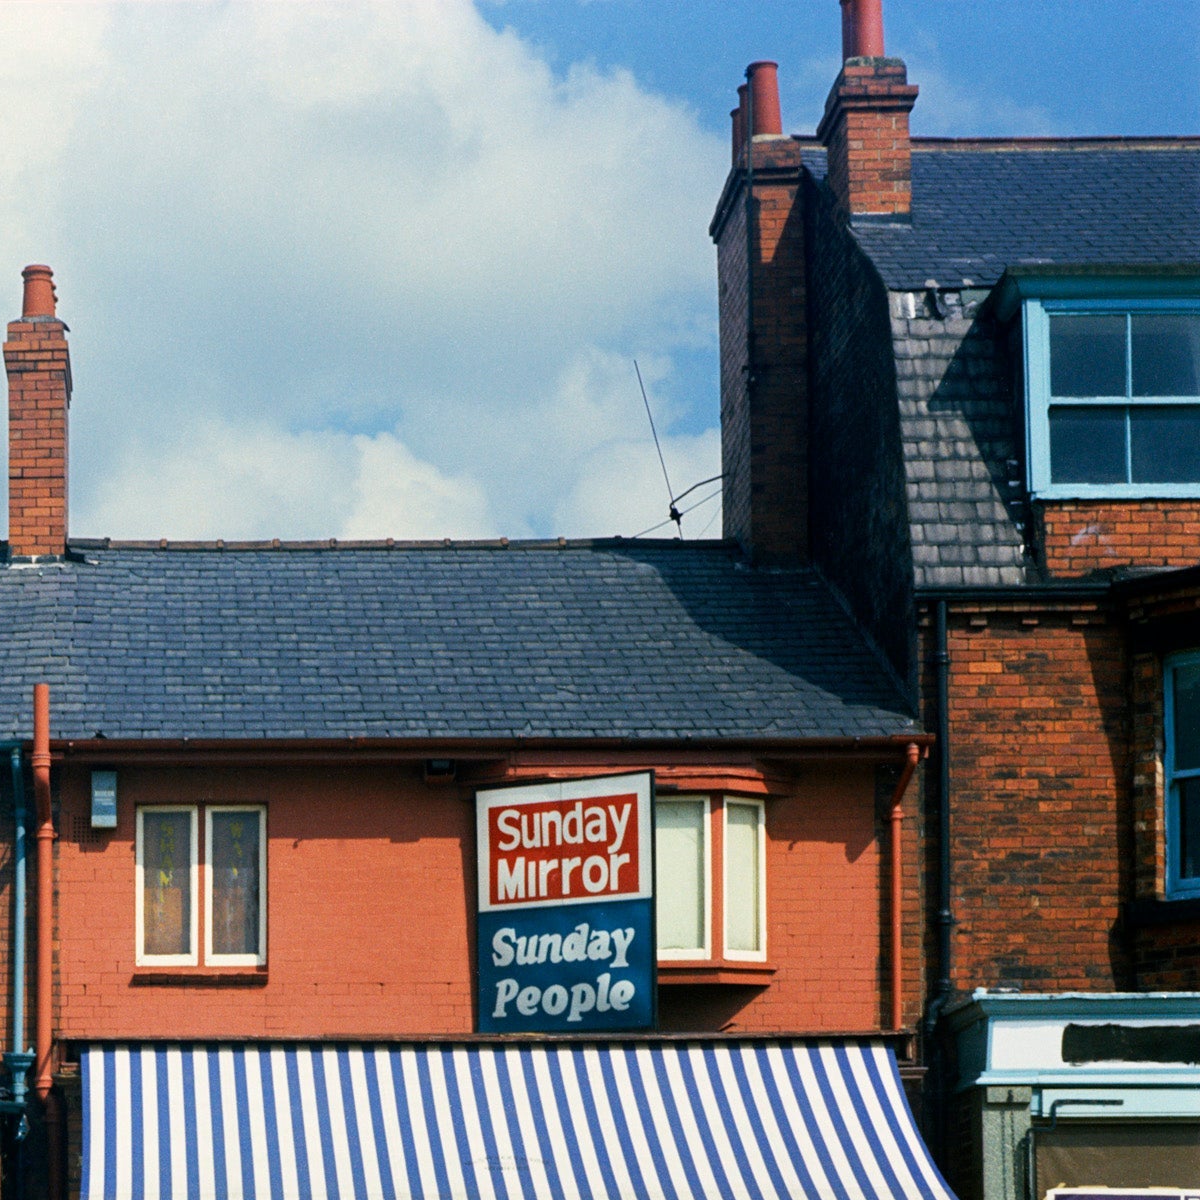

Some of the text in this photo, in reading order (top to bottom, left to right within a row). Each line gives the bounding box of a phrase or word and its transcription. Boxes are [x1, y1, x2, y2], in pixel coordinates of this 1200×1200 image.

[496, 801, 632, 854] Sunday
[496, 852, 631, 901] Mirror
[491, 922, 635, 968] Sunday
[491, 972, 635, 1022] People
